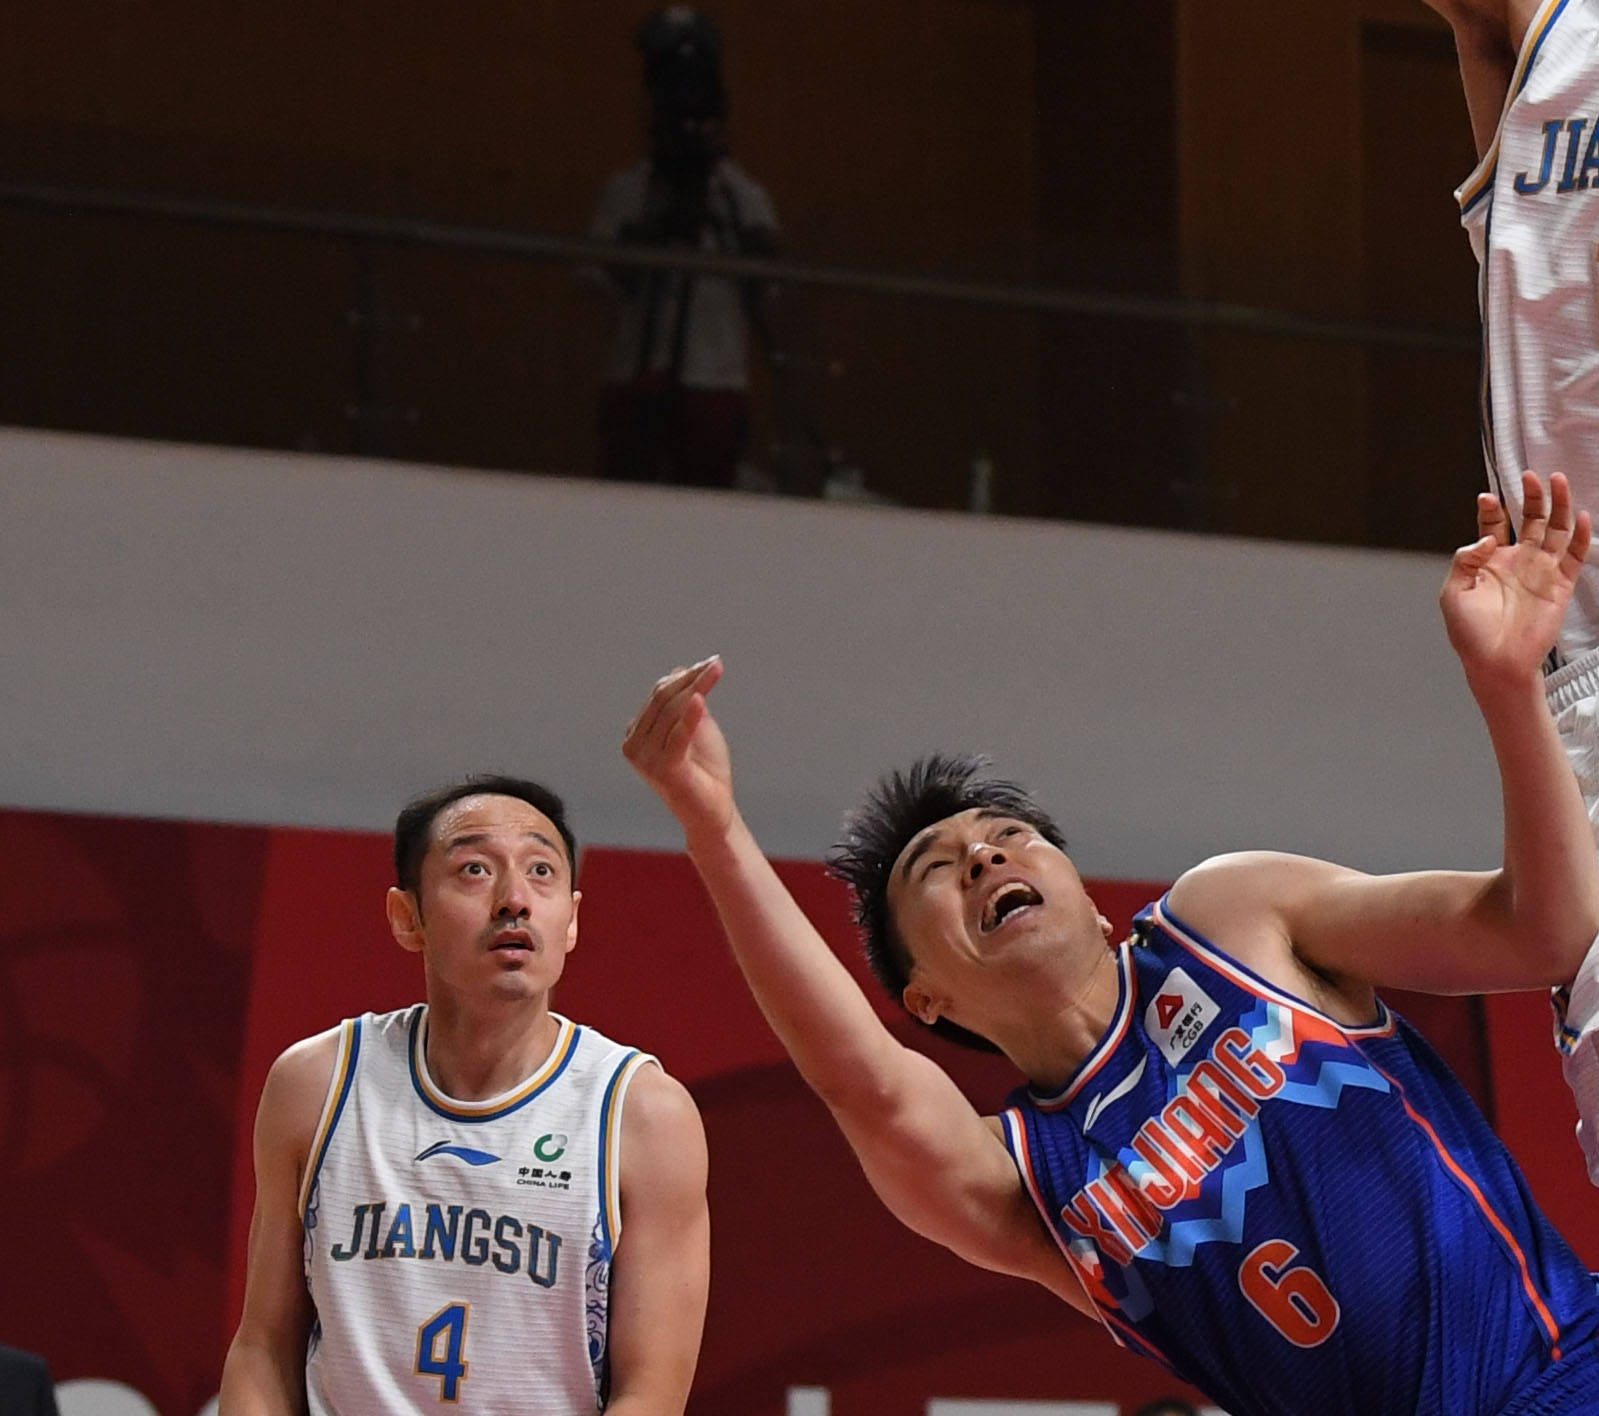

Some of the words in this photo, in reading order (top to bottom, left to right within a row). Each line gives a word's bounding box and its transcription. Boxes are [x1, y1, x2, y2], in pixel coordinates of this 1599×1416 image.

[1182, 1020, 1204, 1049] CGB
[516, 1179, 546, 1187] CHINA
[549, 1182, 570, 1190] LIFE
[1060, 1026, 1287, 1266] XINJIANG
[331, 1202, 562, 1288] JIANGSU
[1238, 1239, 1341, 1348] 6
[413, 1301, 471, 1404] 4
